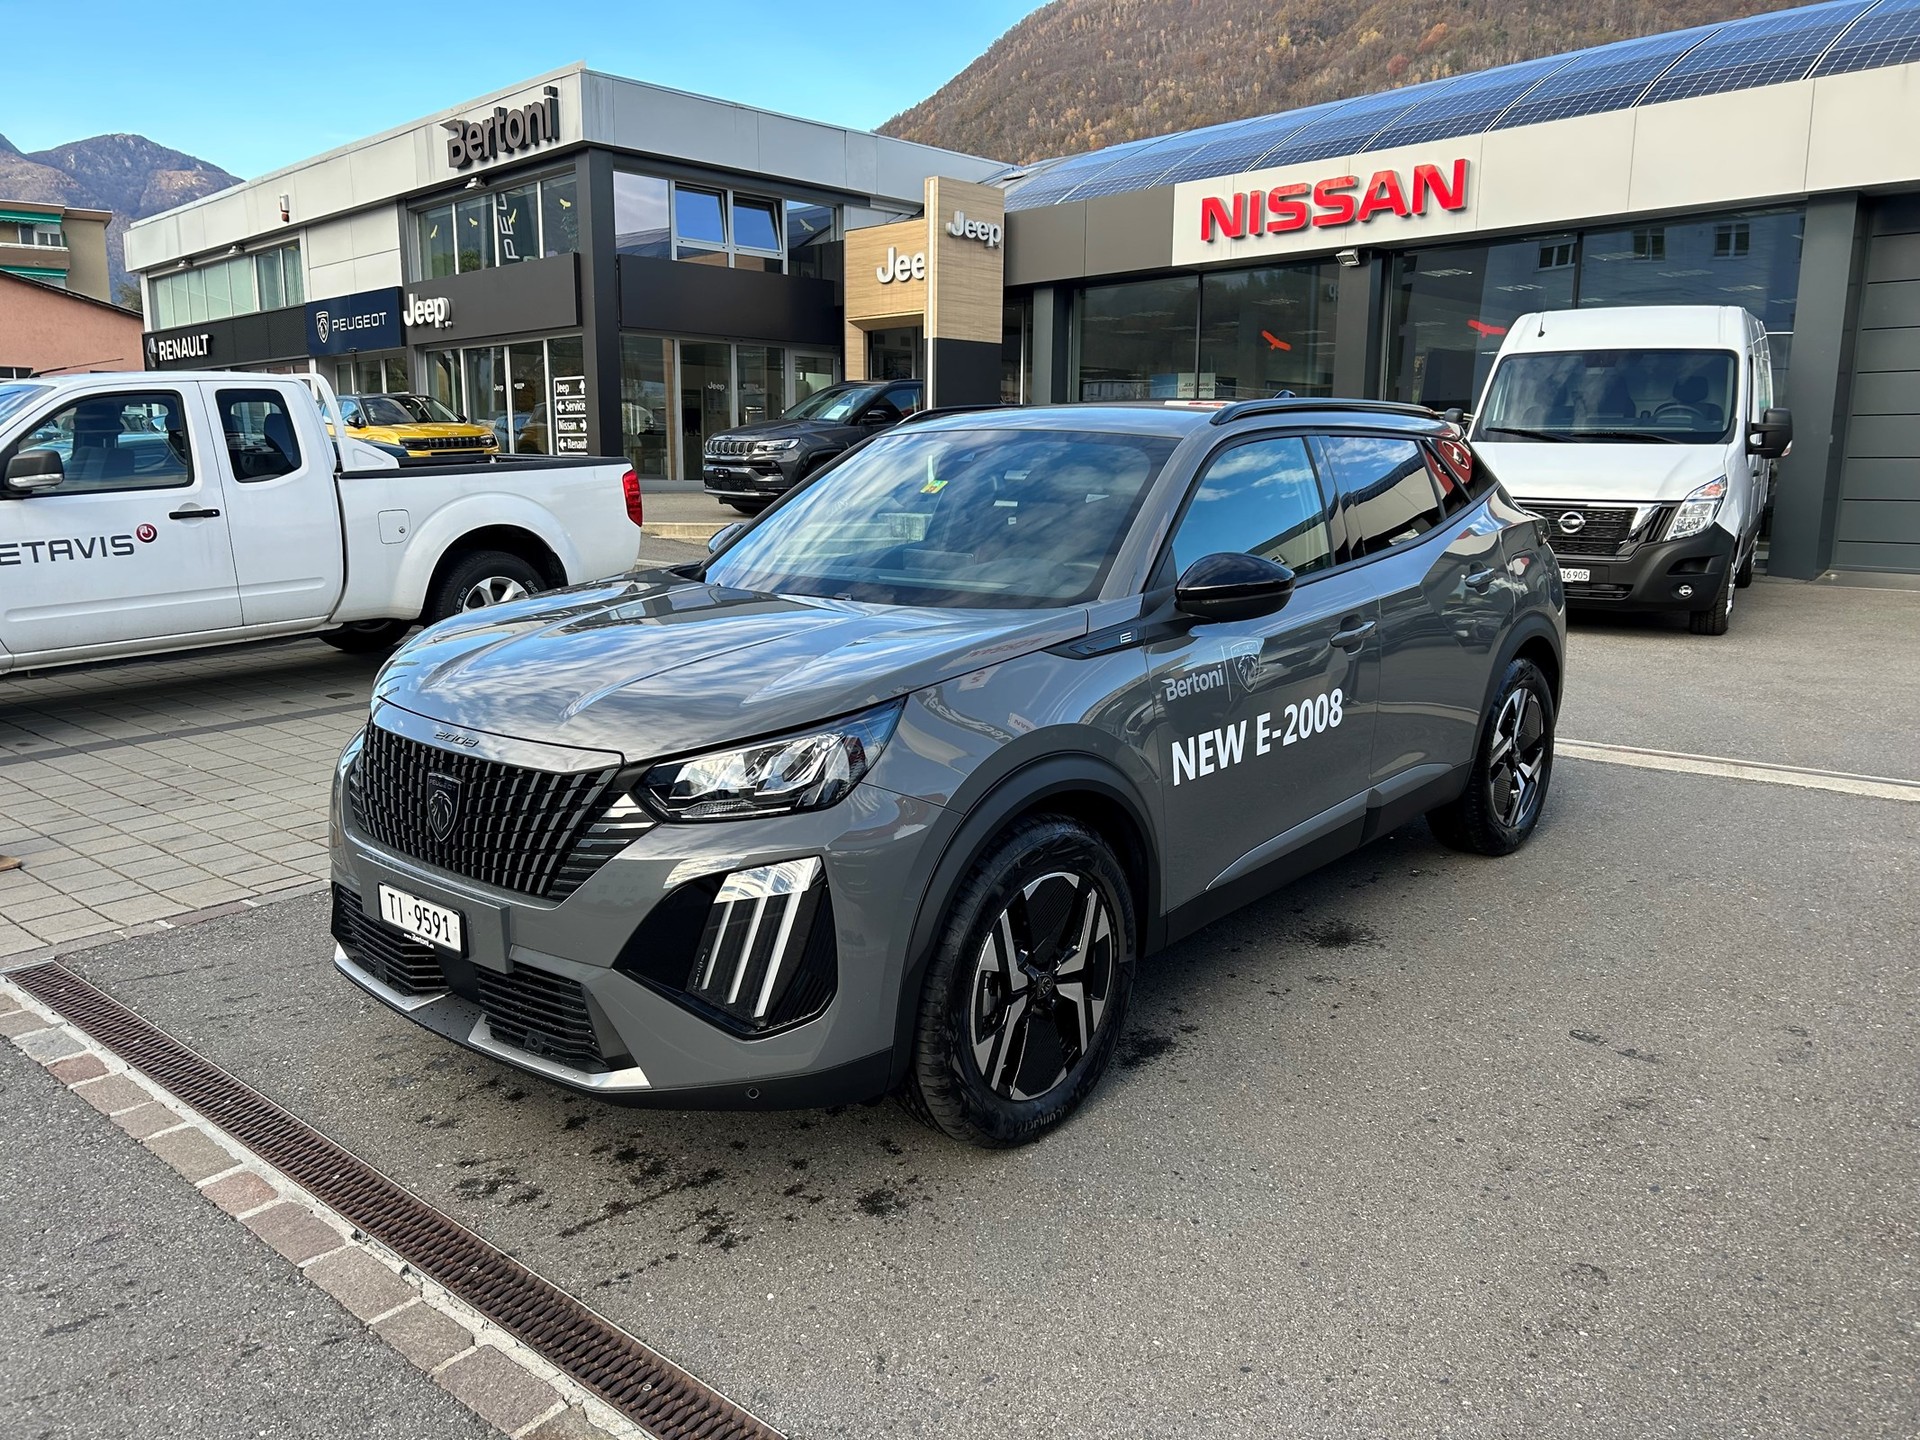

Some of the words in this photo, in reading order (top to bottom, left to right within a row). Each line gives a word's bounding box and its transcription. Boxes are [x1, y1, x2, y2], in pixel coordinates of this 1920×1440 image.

[440, 85, 557, 168] Bertoni
[1200, 158, 1471, 242] NISSAN
[945, 210, 1002, 248] Jeep
[876, 246, 925, 284] Jee
[331, 311, 387, 332] PEUGEOT
[403, 293, 451, 328] Jeep
[158, 333, 210, 362] RENAULT
[556, 383, 570, 395] Jeep
[707, 381, 725, 392] Jeep
[565, 400, 586, 412] Service
[558, 420, 577, 431] Nissan
[0, 534, 135, 566] ETAVIS
[1161, 665, 1224, 702] Bertoni
[433, 731, 480, 748] 2008
[1171, 720, 1247, 787] NEW
[1256, 688, 1343, 756] E-2008
